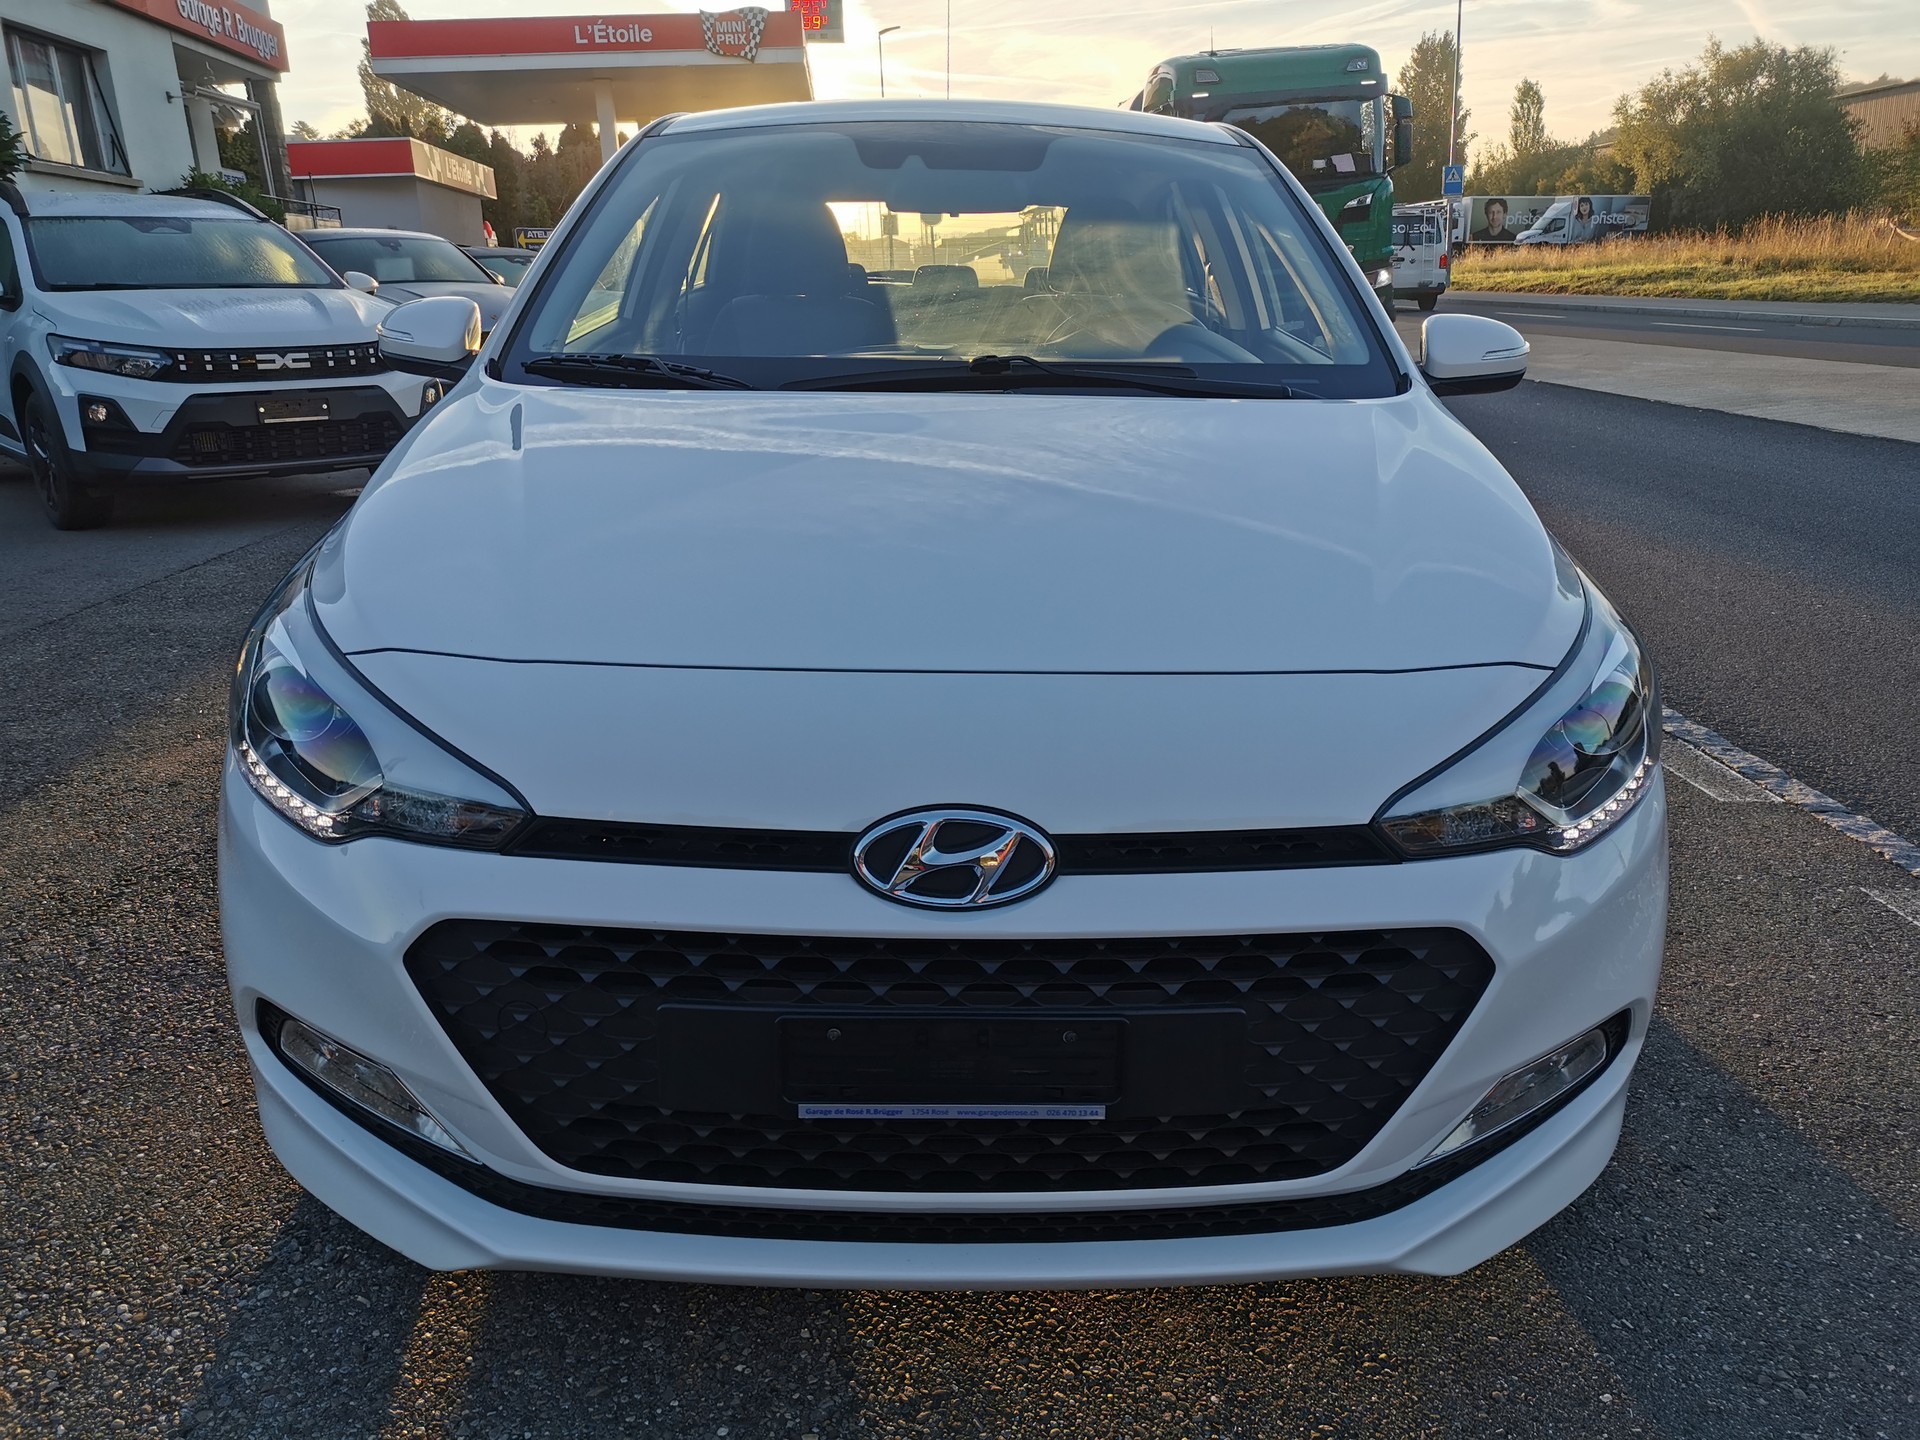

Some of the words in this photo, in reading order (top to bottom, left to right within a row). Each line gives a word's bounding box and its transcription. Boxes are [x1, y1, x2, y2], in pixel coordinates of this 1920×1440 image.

[177, 0, 221, 37] Garage
[716, 20, 746, 33] MINI
[574, 19, 653, 44] L'Étoile
[717, 33, 748, 45] PRIX
[1505, 211, 1542, 228] pfiste
[1591, 211, 1629, 228] pfister
[805, 1108, 833, 1116] Garage
[957, 1109, 1039, 1117] www.garagederose.ch
[1046, 1109, 1060, 1117] 026
[1062, 1109, 1076, 1117] 470
